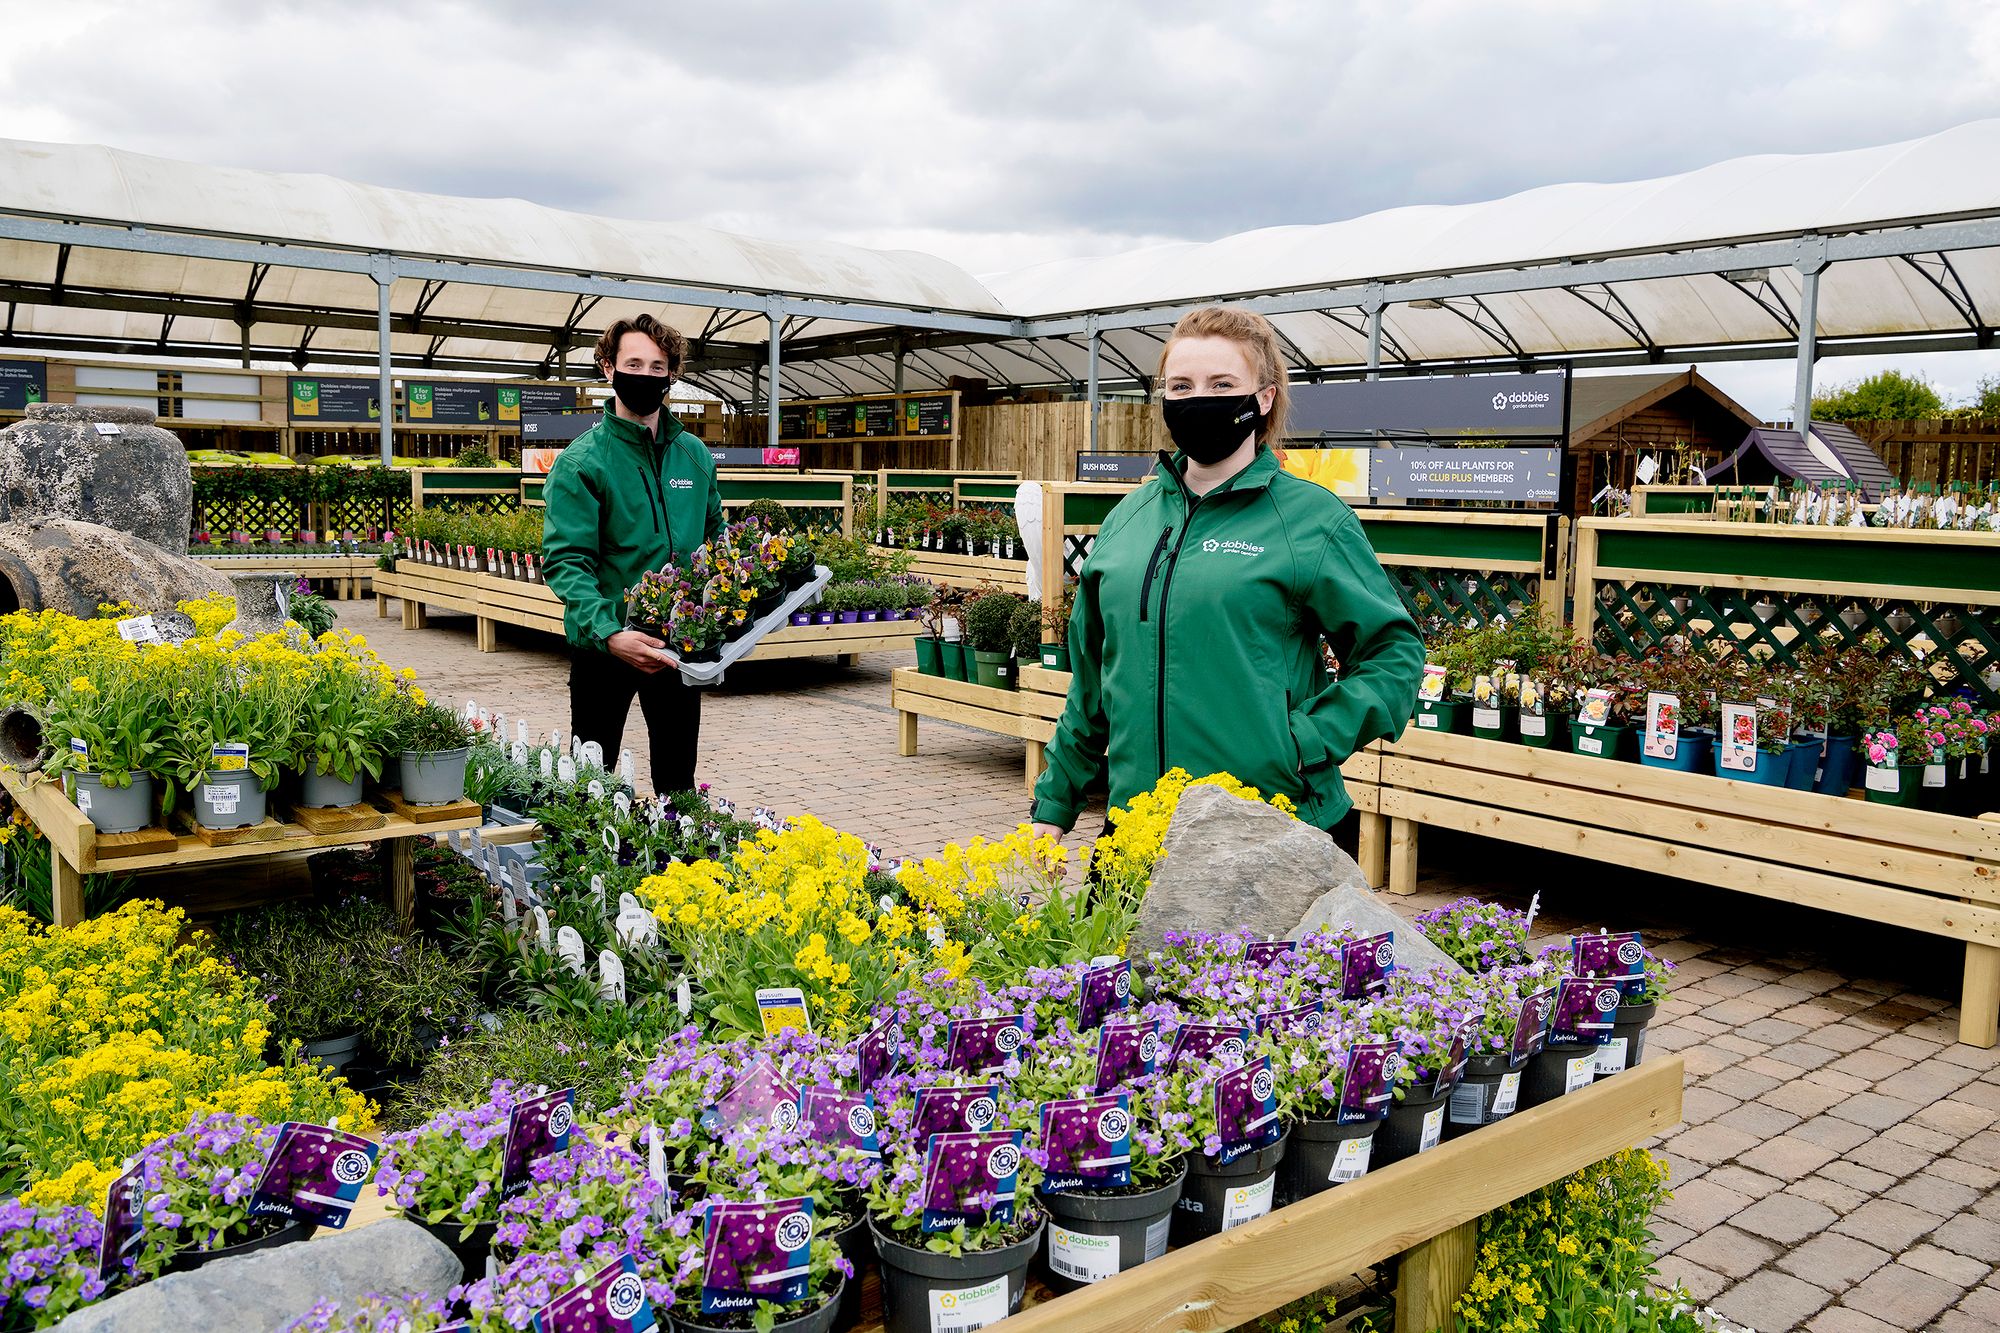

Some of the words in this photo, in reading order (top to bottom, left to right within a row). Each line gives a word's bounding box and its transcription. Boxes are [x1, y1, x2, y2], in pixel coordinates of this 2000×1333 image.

[1509, 391, 1549, 402] dobbies
[524, 424, 537, 432] ROSES
[1411, 461, 1426, 469] 10%
[1445, 462, 1460, 470] ALL
[1462, 462, 1495, 470] PLANTS
[1497, 462, 1514, 470] FOR
[1410, 473, 1427, 481] OUR
[1429, 473, 1450, 481] CLUB
[1451, 474, 1472, 482] PLUS
[1474, 474, 1514, 482] MEMBERS
[1221, 540, 1264, 552] dobbies
[1048, 1179, 1083, 1189] Aubrieta
[254, 1202, 292, 1215] Aubrieta
[929, 1217, 966, 1228] Aubrieta
[1069, 1234, 1110, 1247] dobbies
[958, 1283, 1000, 1301] dobbies
[710, 1297, 754, 1309] Aubrieta
